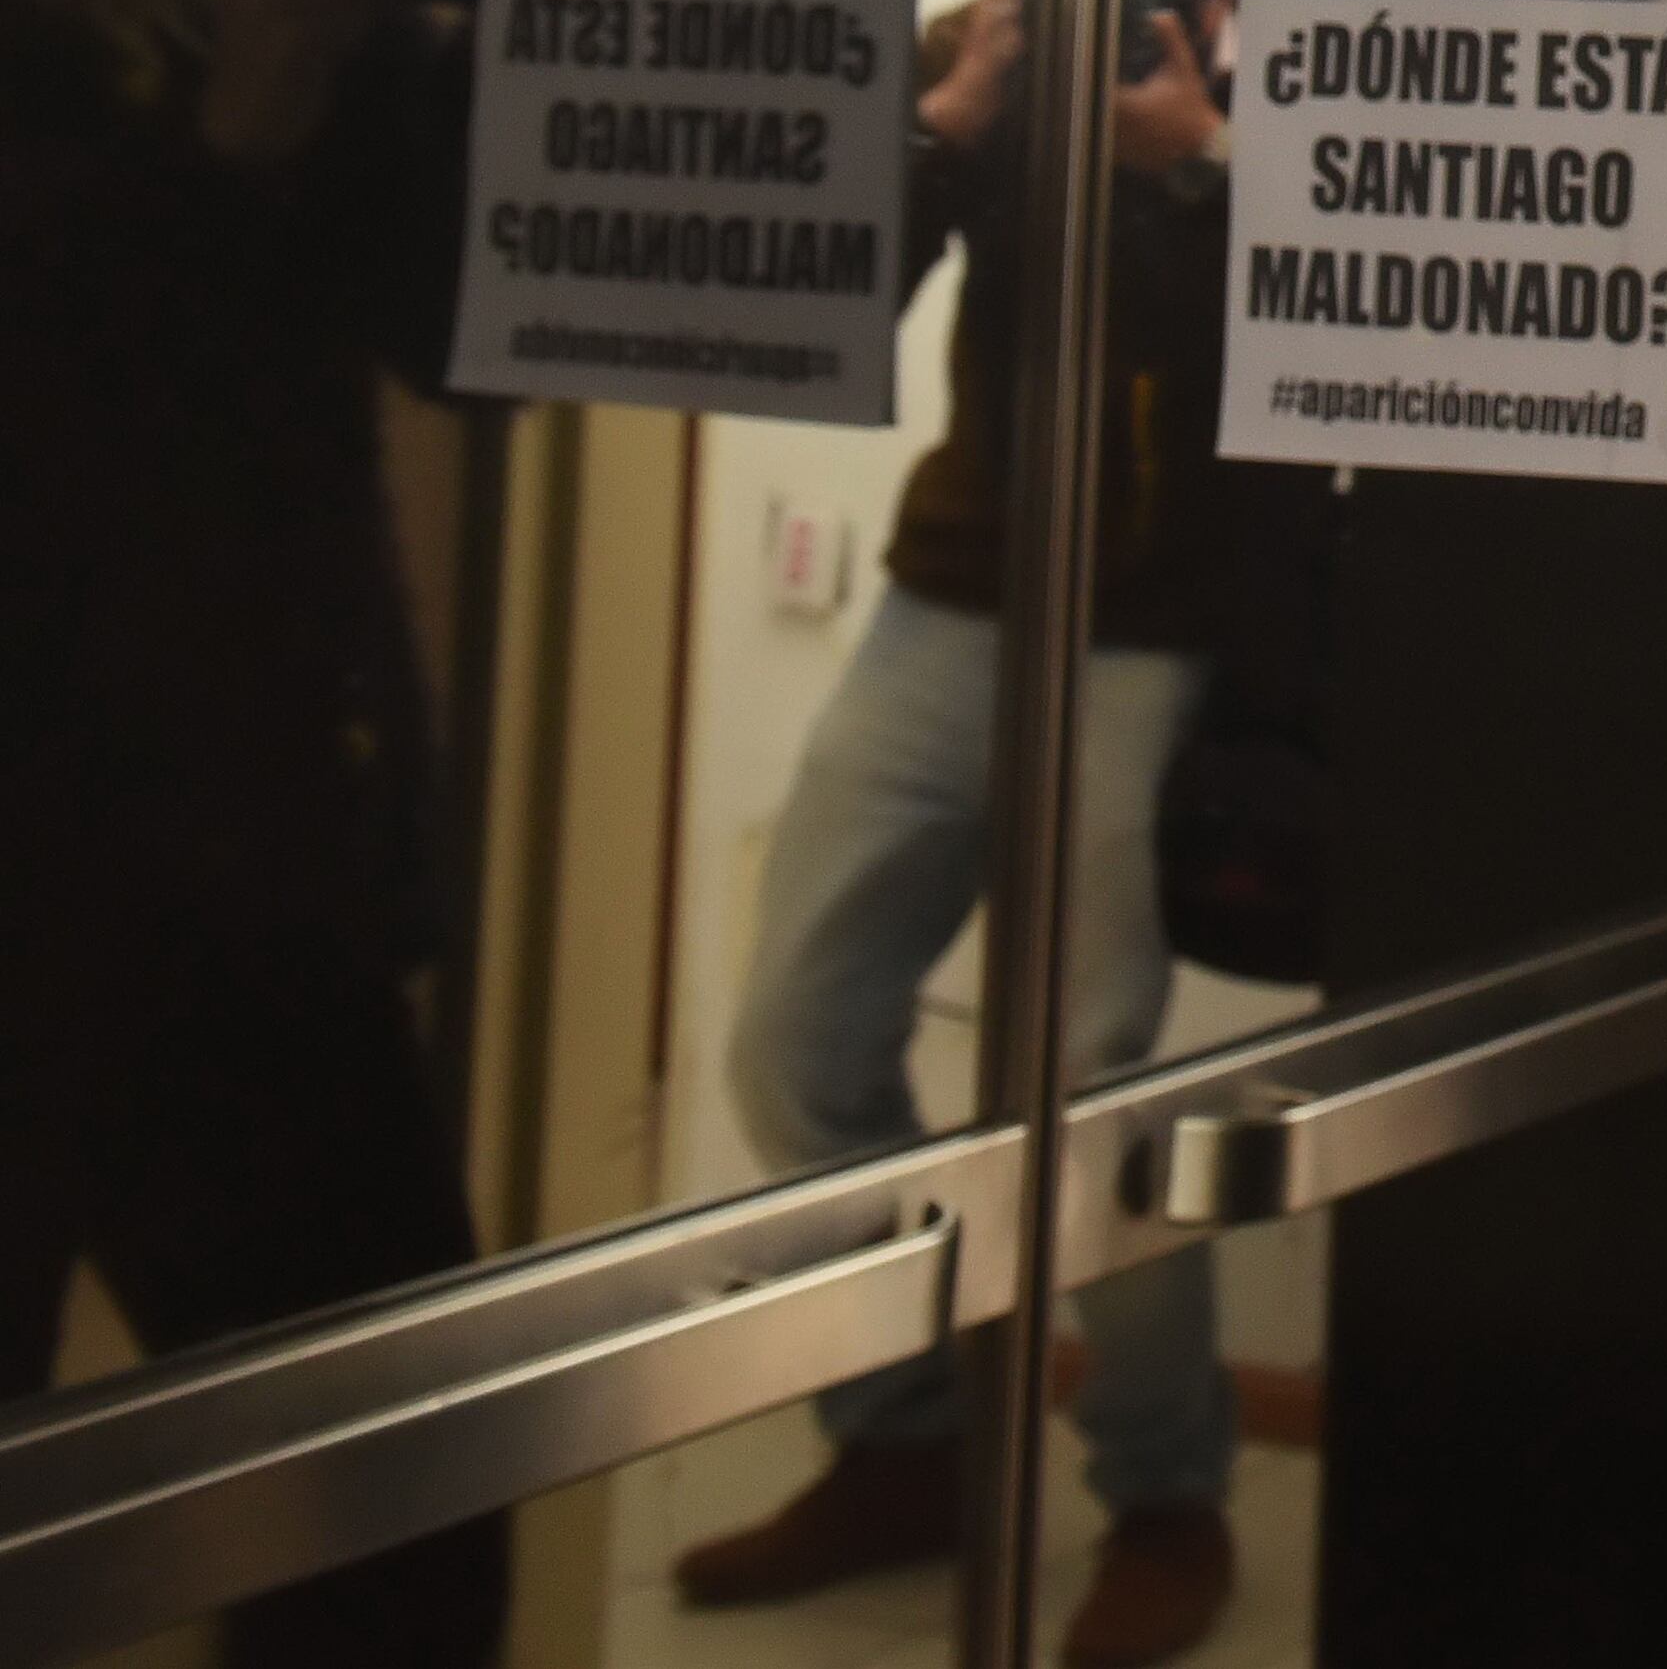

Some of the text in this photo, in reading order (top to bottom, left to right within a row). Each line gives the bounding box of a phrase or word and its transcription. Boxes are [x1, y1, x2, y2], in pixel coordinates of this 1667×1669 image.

[1265, 10, 1516, 109] ¿DÓNDE
[1310, 136, 1636, 229] SANTIAGO
[1269, 374, 1647, 440] #apariciónconvida
